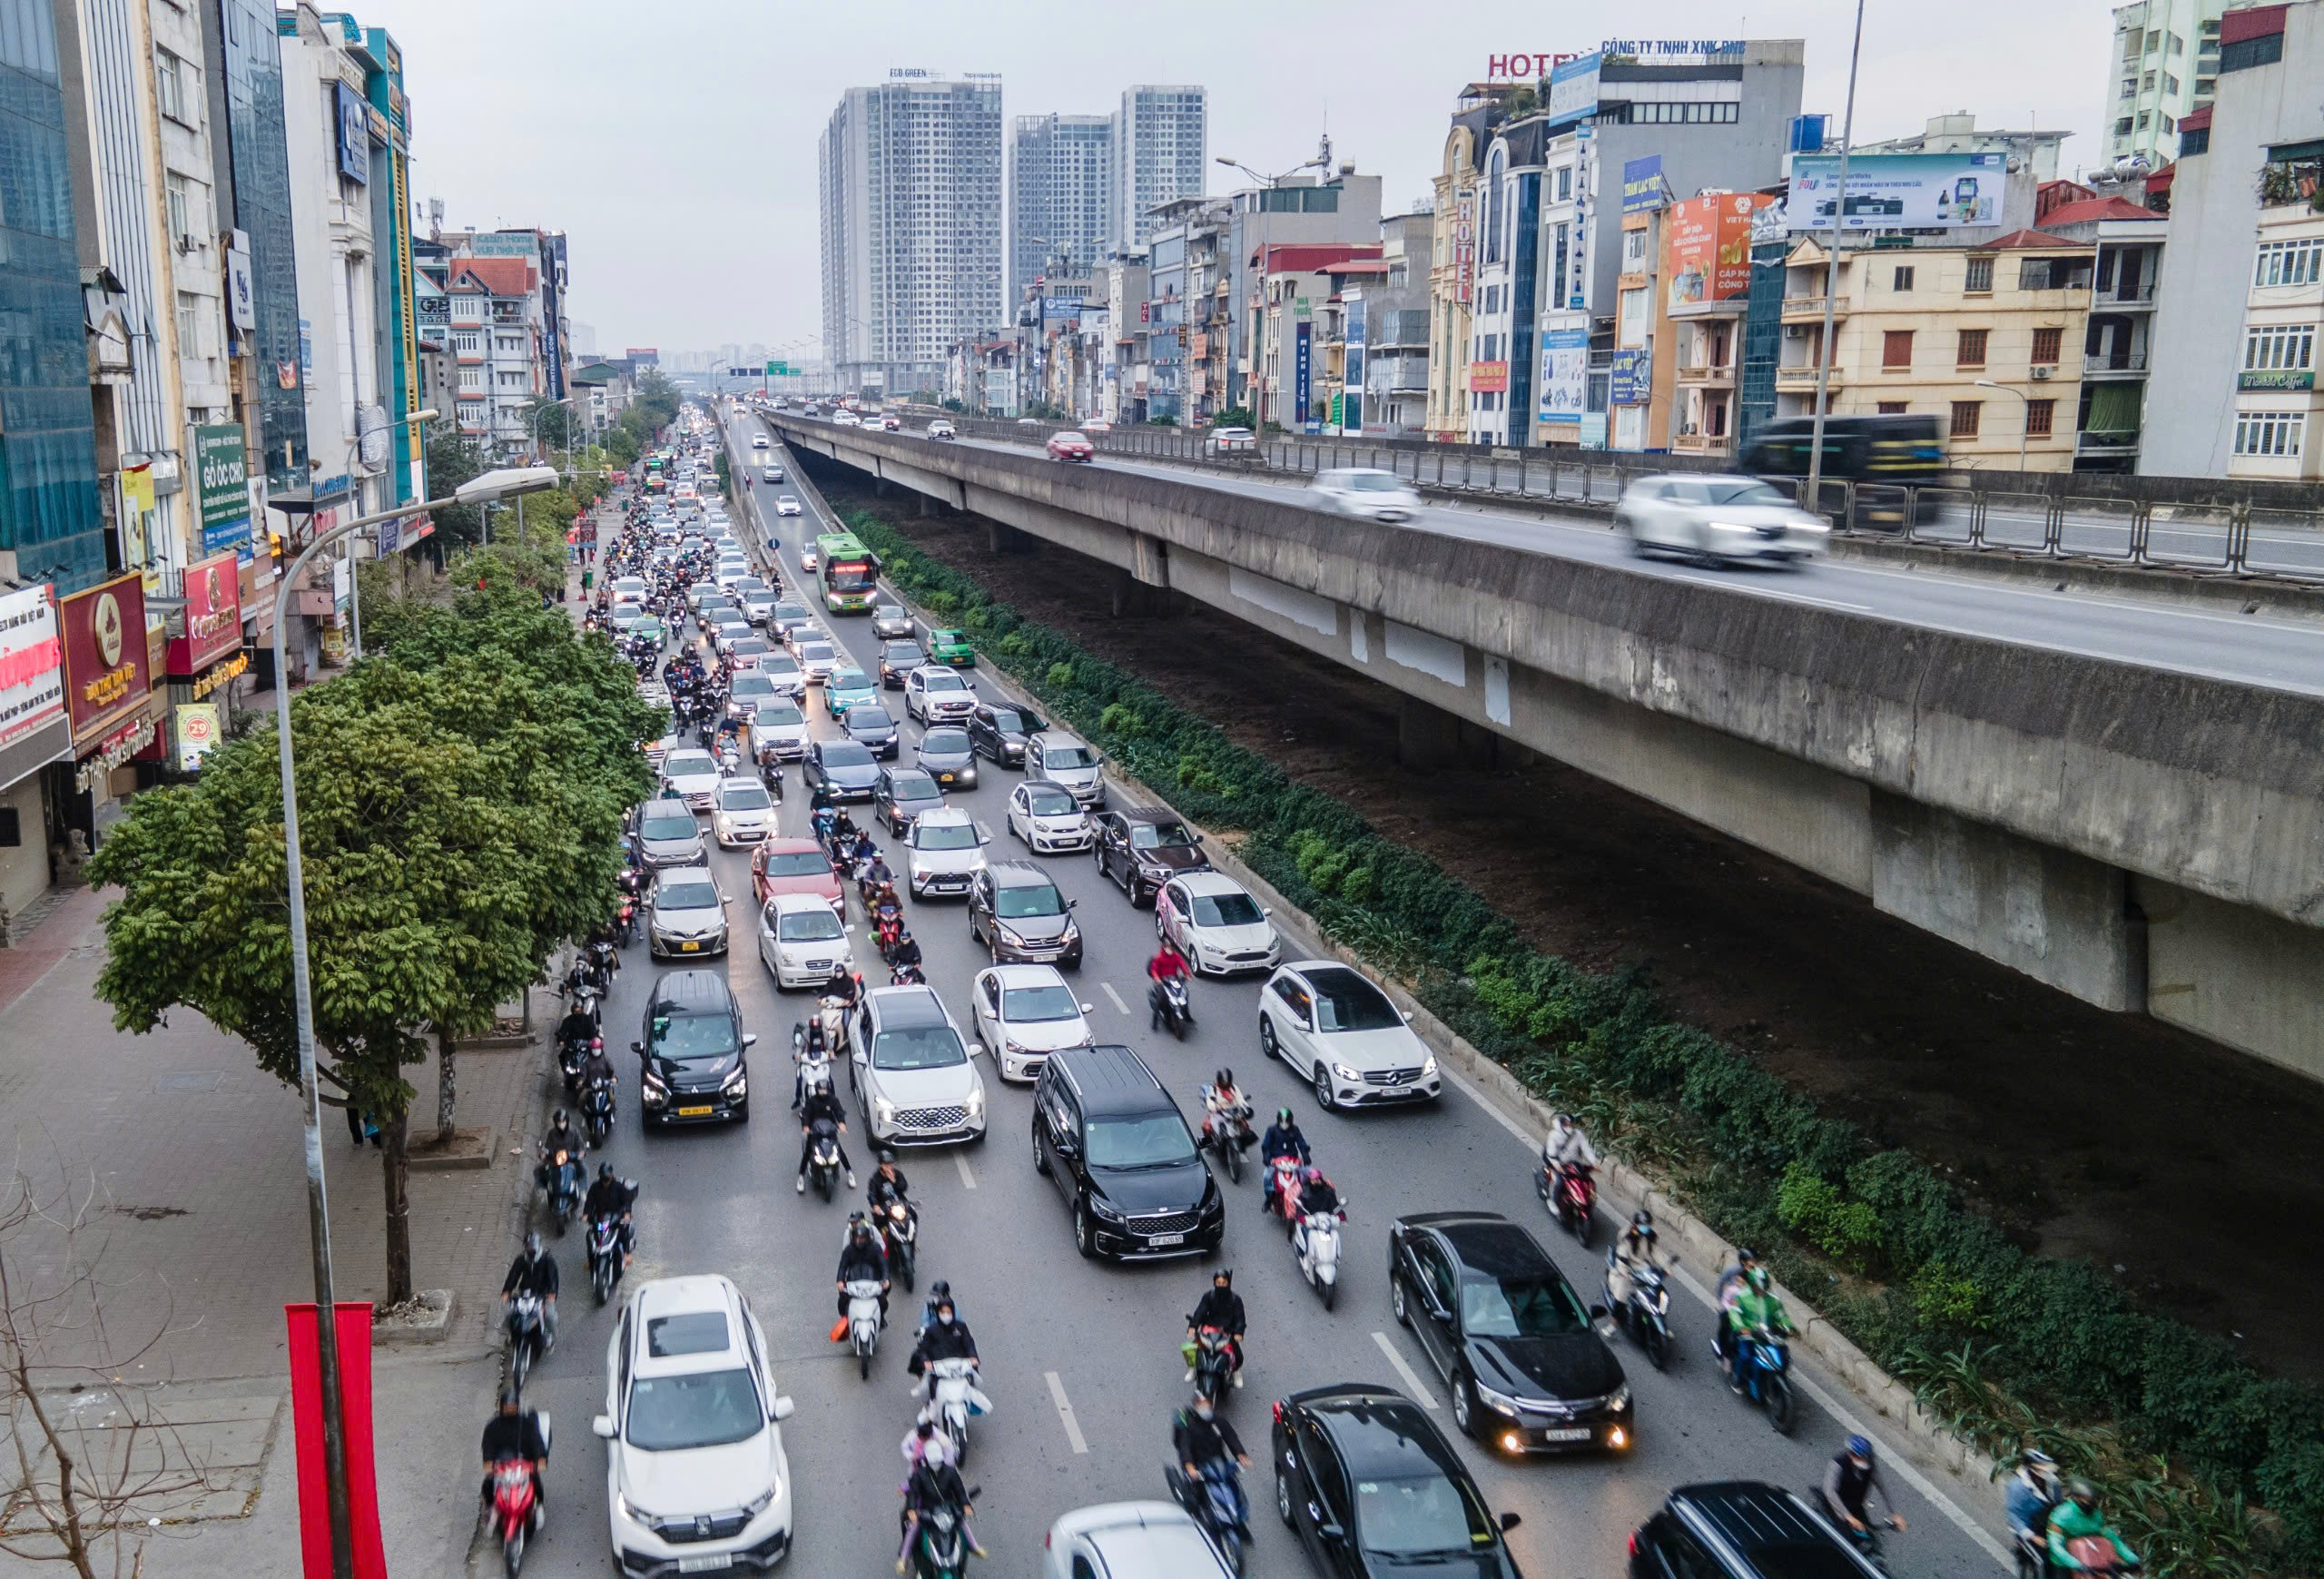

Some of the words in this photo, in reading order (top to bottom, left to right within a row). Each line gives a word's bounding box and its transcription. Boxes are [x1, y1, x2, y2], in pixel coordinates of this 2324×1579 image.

[1601, 37, 1635, 54] CÔNG
[1639, 41, 1652, 54] TY
[1657, 41, 1689, 54] TNHH
[890, 68, 903, 78] ECO
[905, 69, 927, 78] GREEN
[1489, 54, 1579, 77] HOTE
[1456, 202, 1472, 303] HOTEL
[203, 455, 216, 489] GỖ
[217, 459, 228, 486] ÓC
[229, 455, 244, 485] CHÓ
[190, 723, 207, 735] 29
